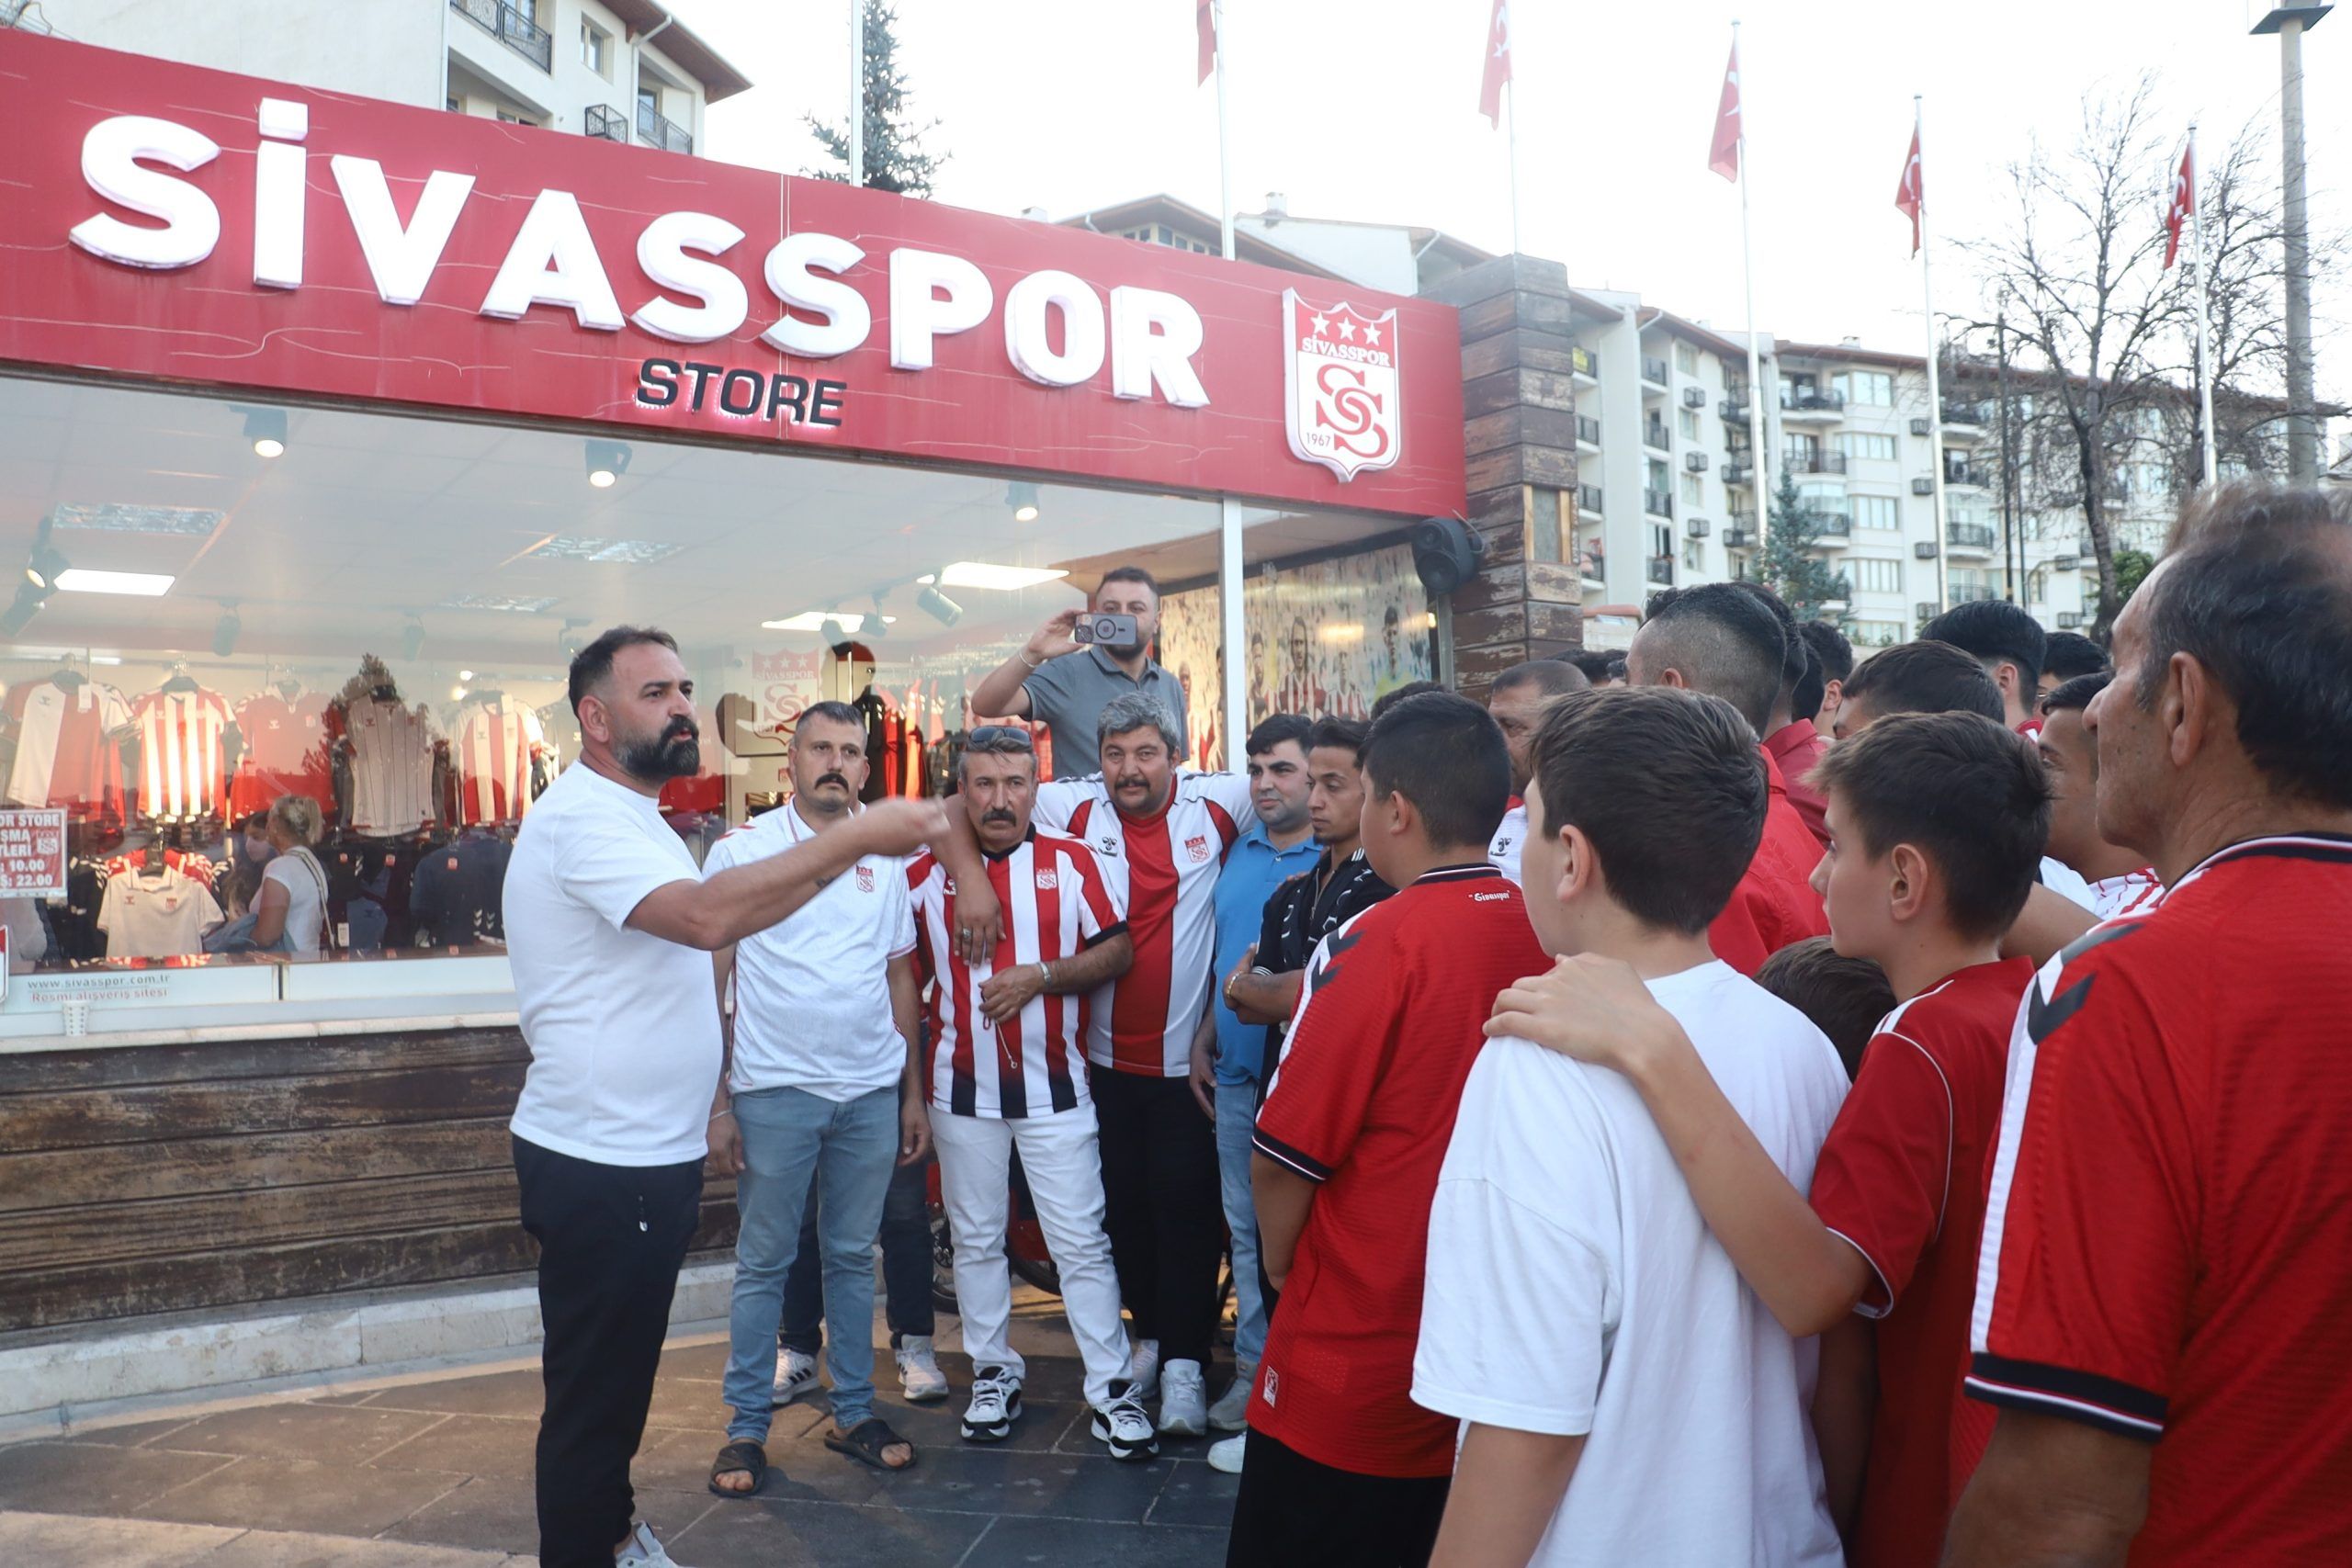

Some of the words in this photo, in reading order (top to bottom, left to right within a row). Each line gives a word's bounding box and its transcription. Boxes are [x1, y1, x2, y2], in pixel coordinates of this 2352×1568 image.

[69, 97, 1210, 409] SİVASSPOR
[1302, 333, 1391, 367] SİVASSPOR
[637, 358, 848, 429] STORE
[1306, 432, 1331, 447] 1967
[18, 814, 60, 827] STORE
[9, 859, 45, 873] 10.00
[17, 874, 52, 887] 22.00
